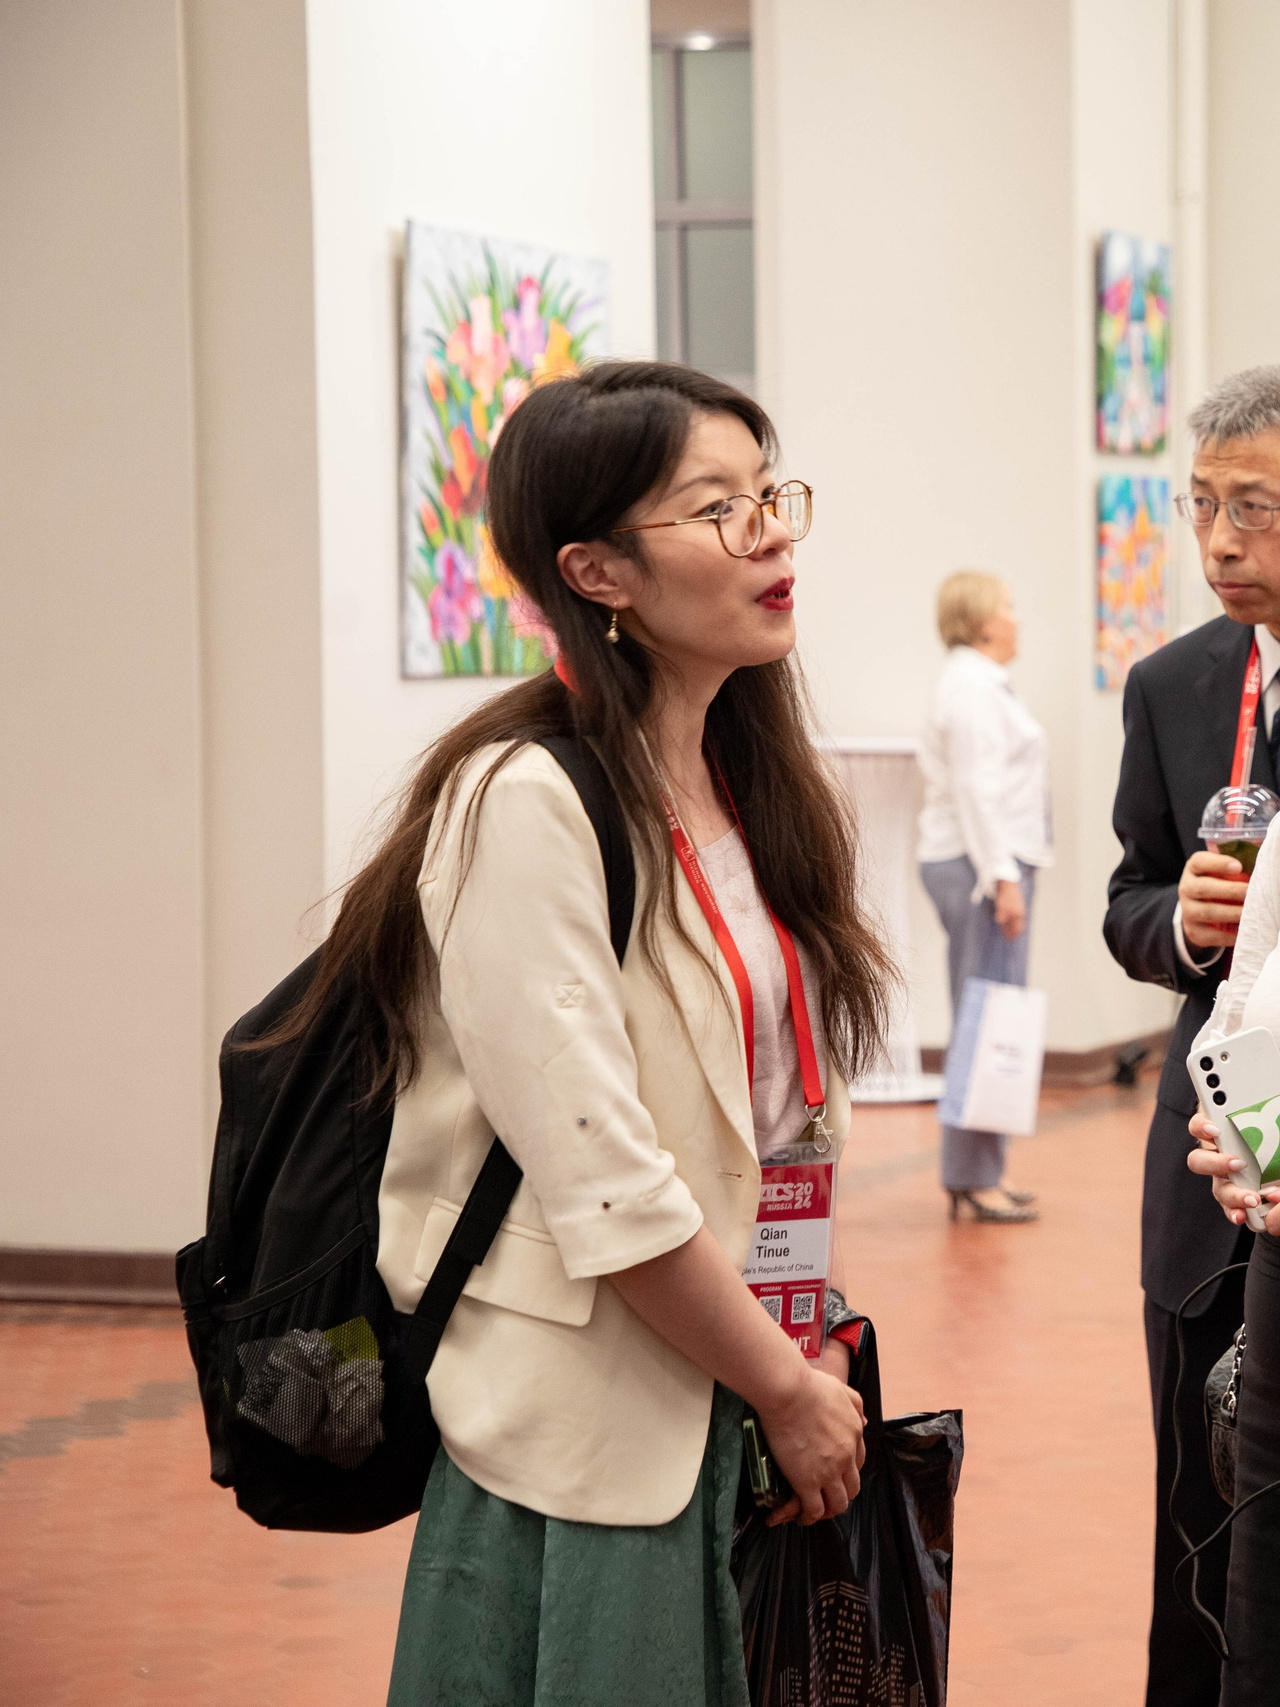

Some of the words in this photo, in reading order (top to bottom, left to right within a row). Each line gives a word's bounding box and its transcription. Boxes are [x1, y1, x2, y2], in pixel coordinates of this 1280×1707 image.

[766, 1202, 792, 1211] RUSSIA
[793, 1195, 812, 1210] 24
[760, 1227, 788, 1241] Qian
[755, 1245, 790, 1259] Tinue
[758, 1263, 786, 1275] Republic
[787, 1263, 795, 1272] of
[795, 1262, 814, 1271] China
[760, 1285, 782, 1293] PROGRAM
